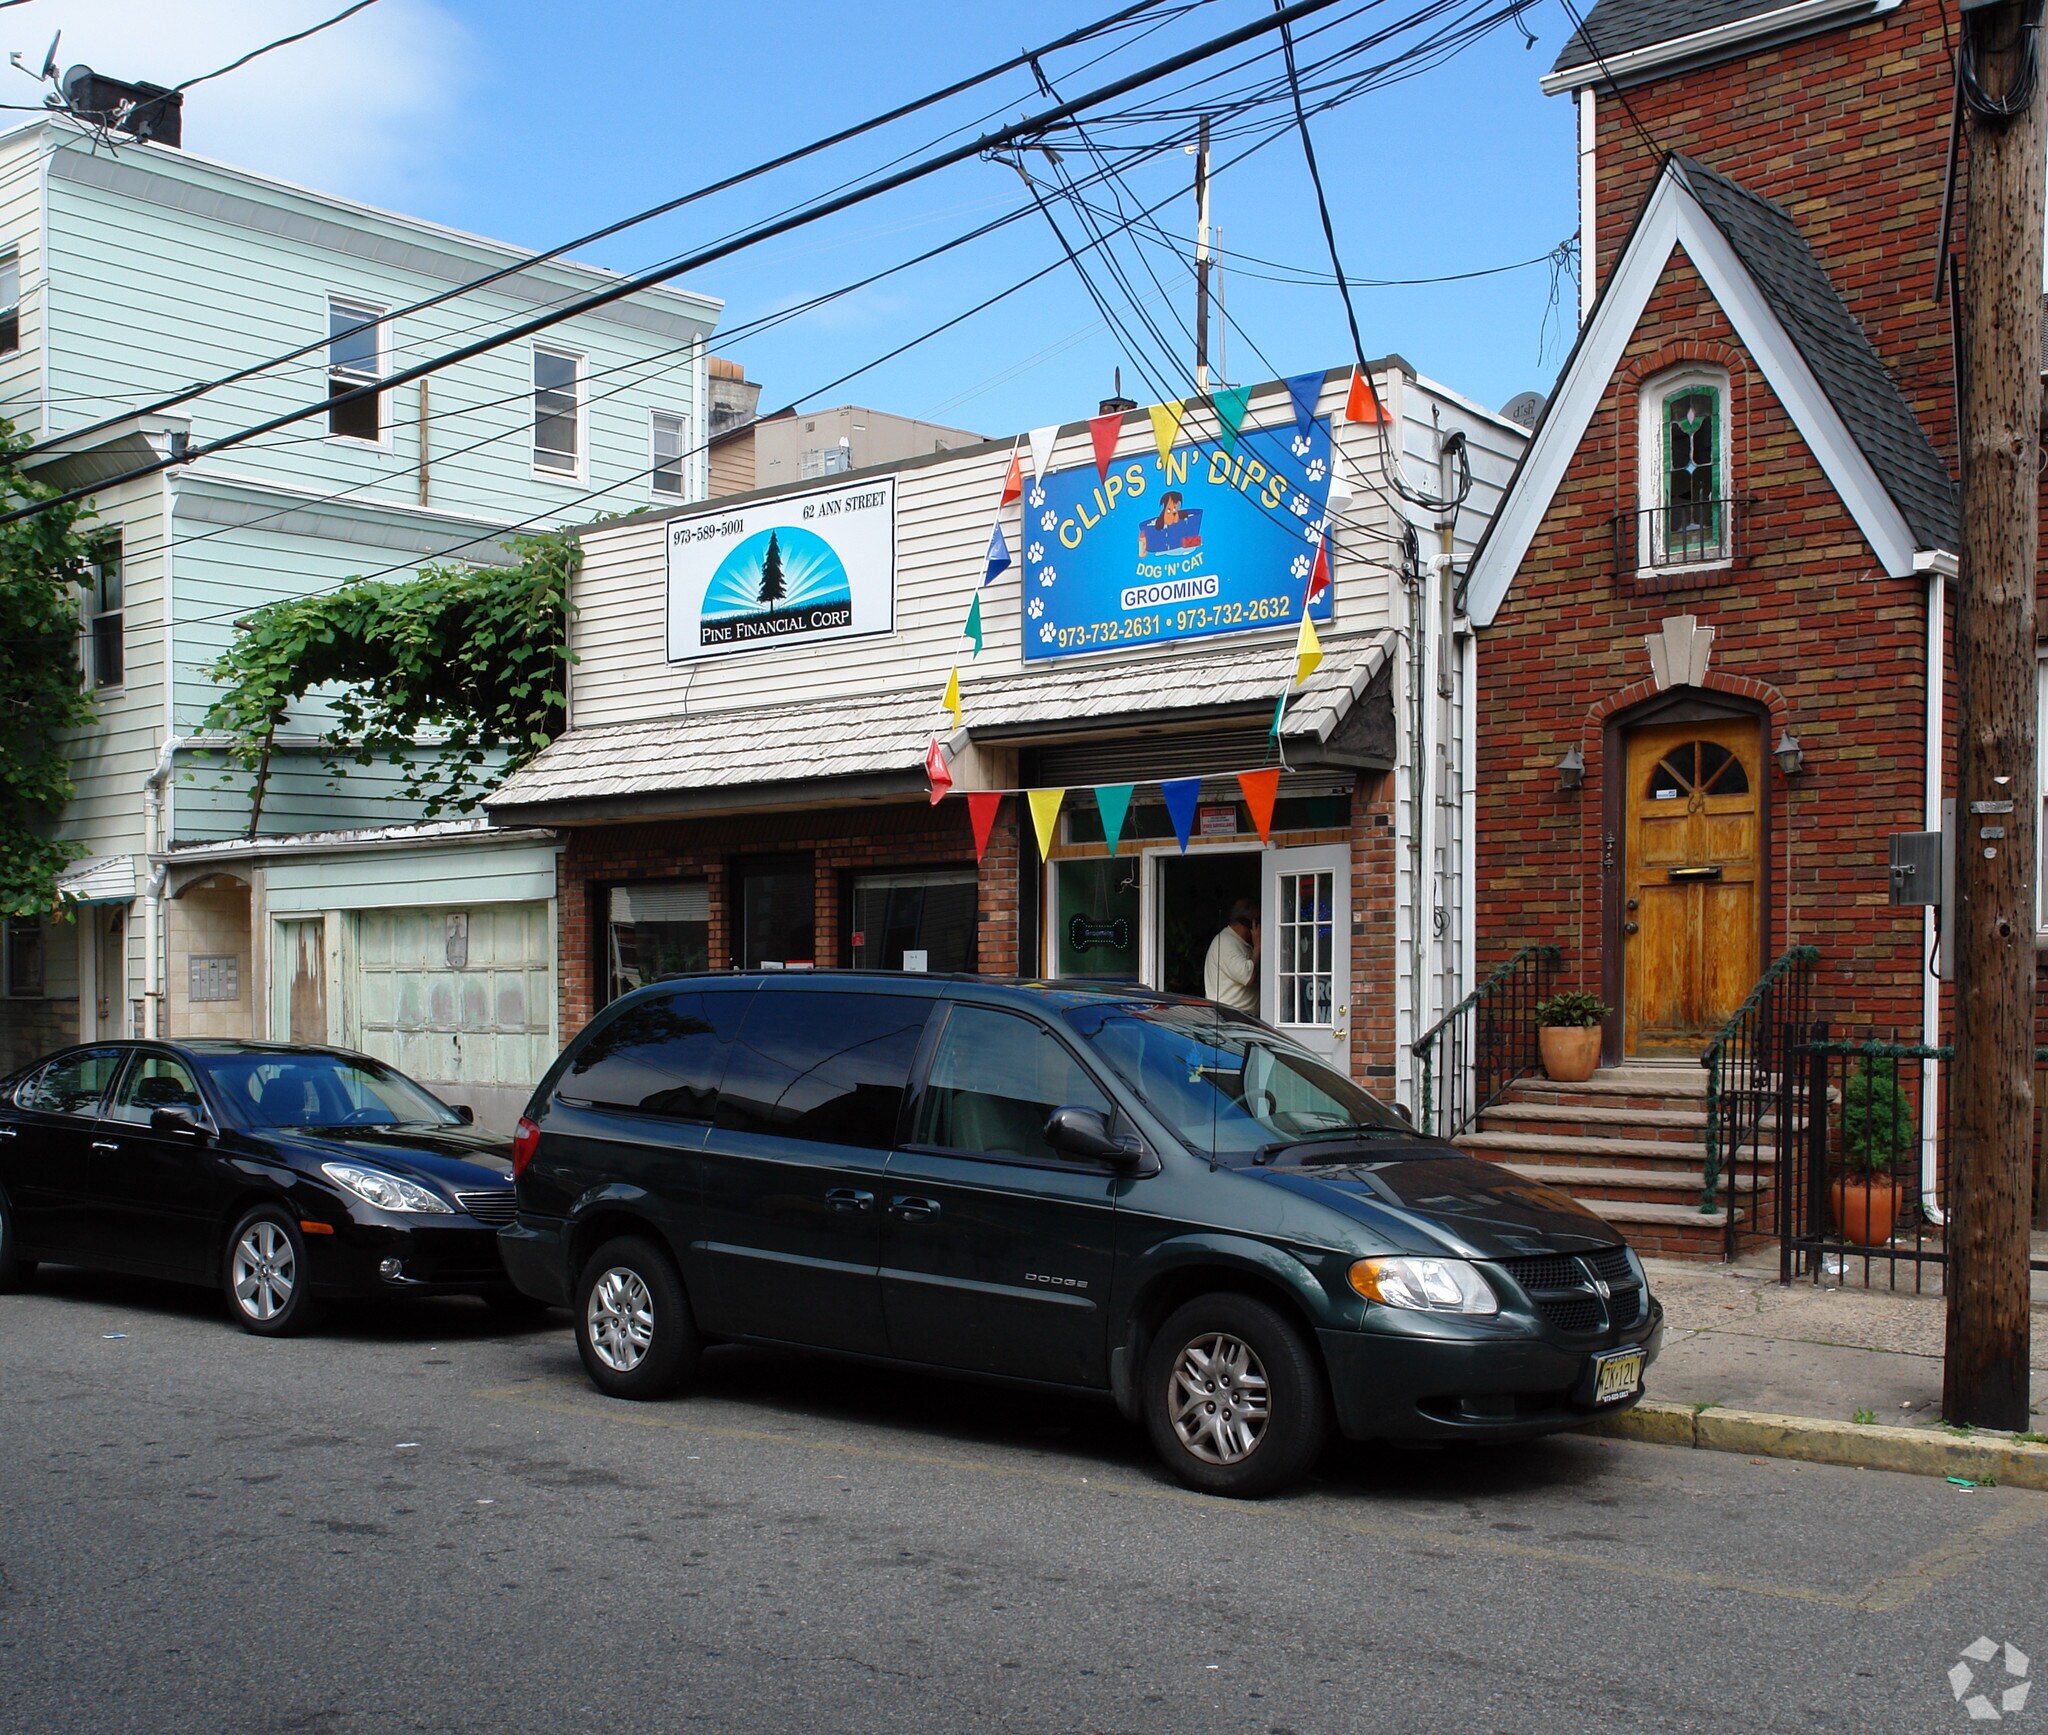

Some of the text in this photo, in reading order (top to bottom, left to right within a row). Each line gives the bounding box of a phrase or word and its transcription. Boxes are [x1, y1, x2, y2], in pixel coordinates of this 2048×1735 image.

[1512, 399, 1535, 418] dish
[803, 491, 886, 519] 62 ANN STREET
[1059, 464, 1146, 549] CLIPS
[1208, 450, 1288, 509] DIPS
[1136, 563, 1163, 578] DOG
[1181, 553, 1204, 573] CAT
[1124, 579, 1217, 607] GROOMING
[701, 610, 849, 643] PINE FINANCIAL CORP
[1058, 595, 1290, 648] 973-732-2631 973-732-2632
[1025, 1272, 1089, 1289] DODGE
